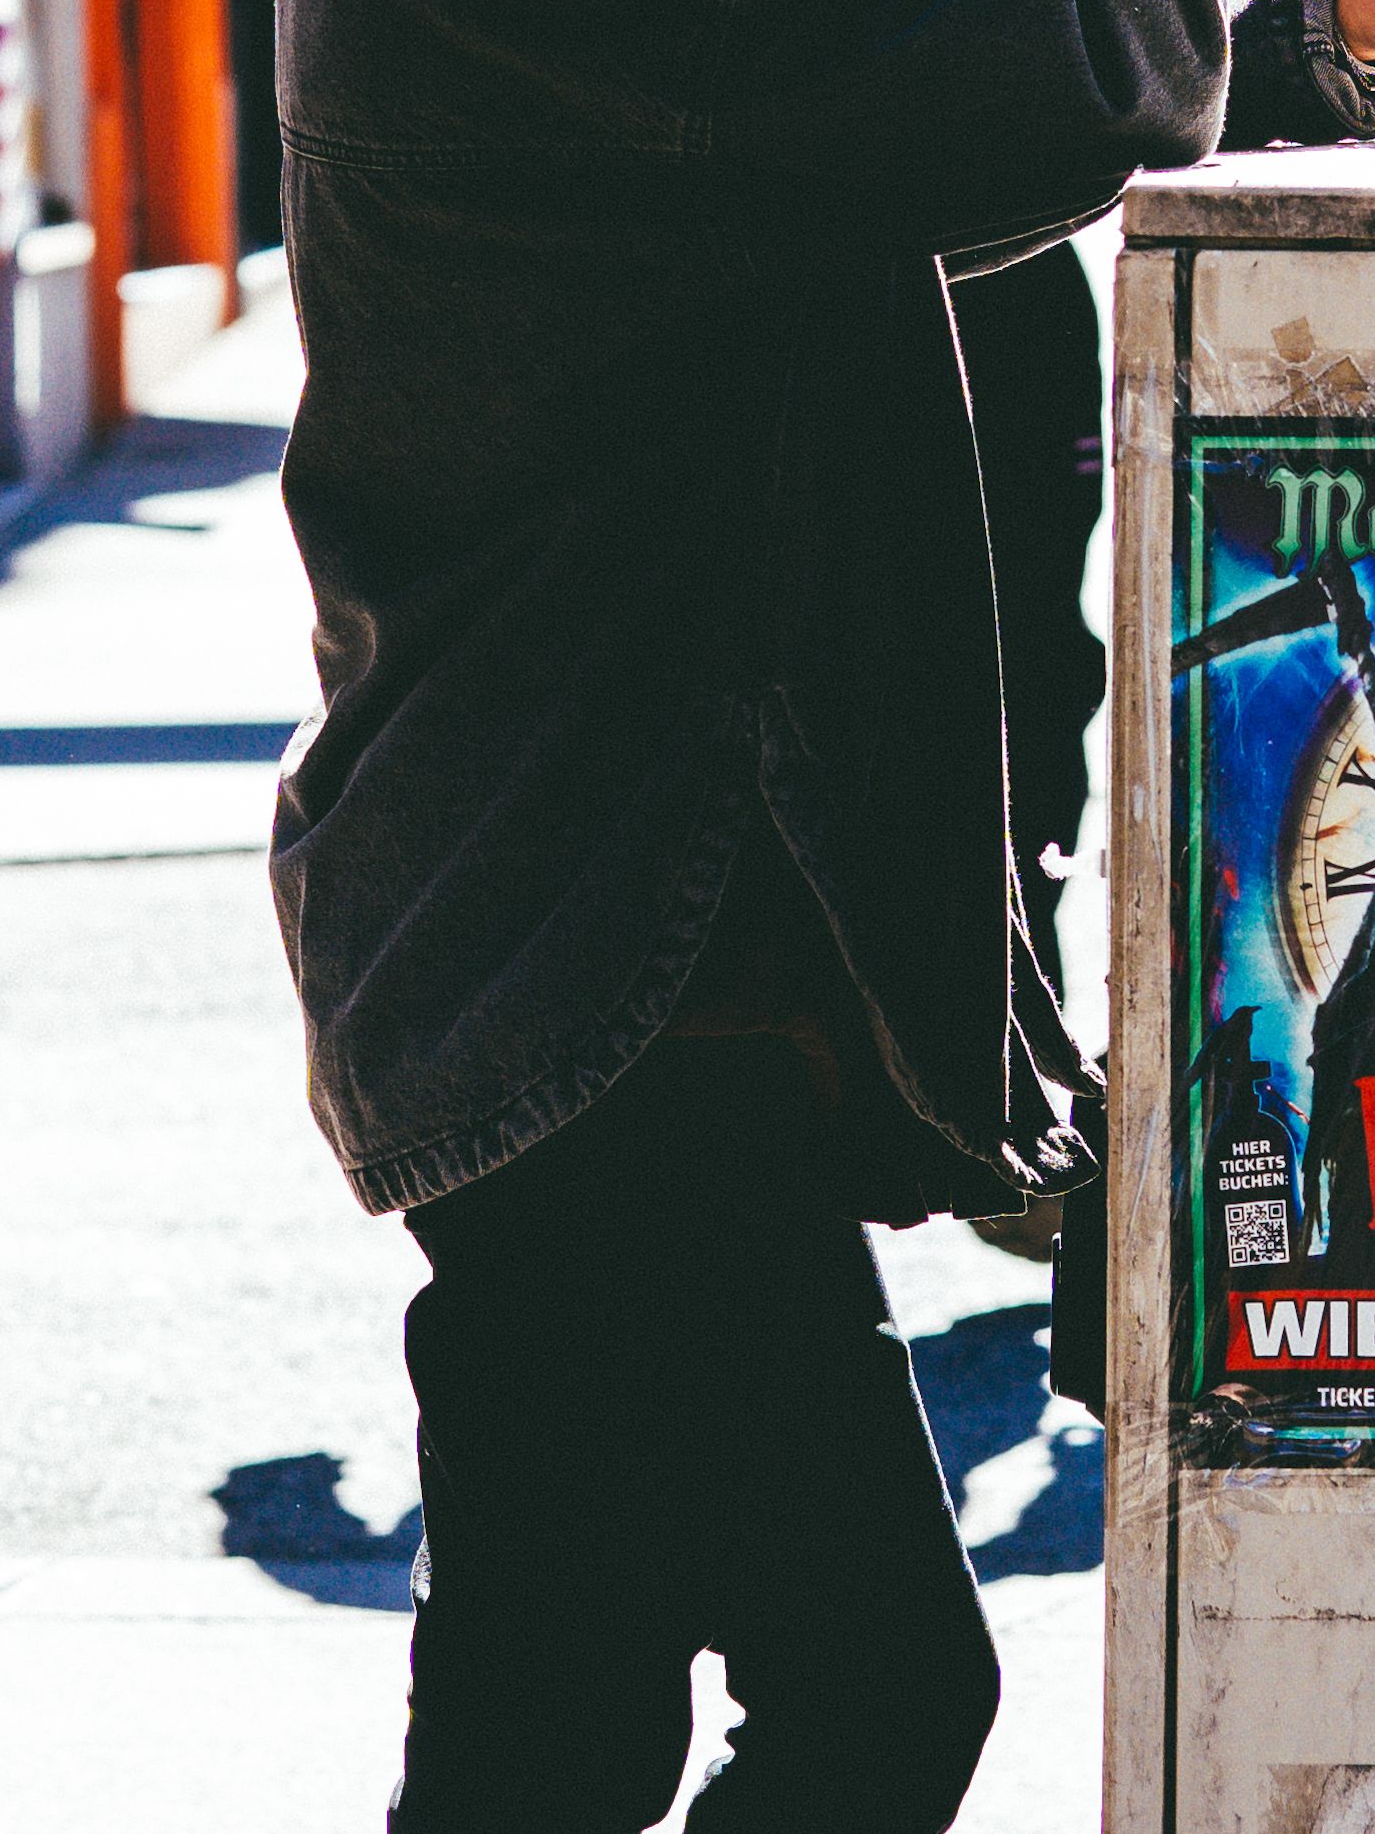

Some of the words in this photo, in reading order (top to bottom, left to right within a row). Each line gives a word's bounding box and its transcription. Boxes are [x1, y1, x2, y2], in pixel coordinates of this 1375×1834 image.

[1232, 1139, 1271, 1156] HIER
[1219, 1155, 1286, 1174] TICKETS
[1219, 1172, 1289, 1191] BUCHEN:
